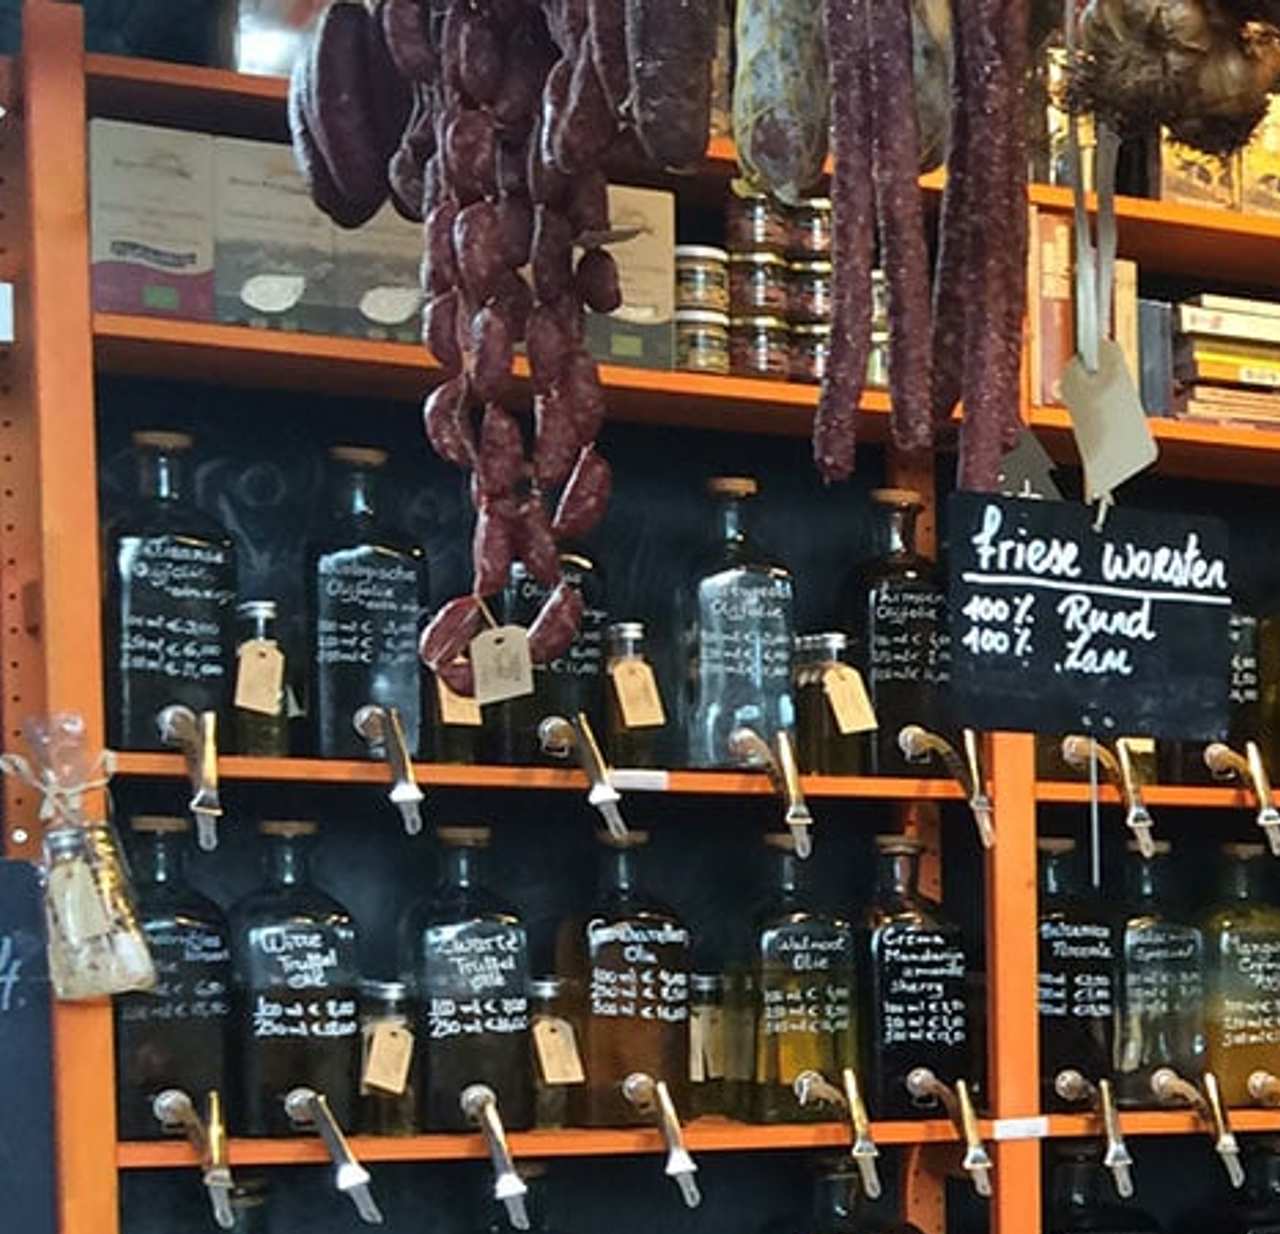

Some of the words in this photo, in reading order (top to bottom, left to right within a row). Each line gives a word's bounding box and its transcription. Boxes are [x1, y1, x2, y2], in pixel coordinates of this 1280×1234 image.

[962, 593, 1034, 624] 100%
[1058, 595, 1155, 640] Rund
[962, 628, 1032, 656] 100%
